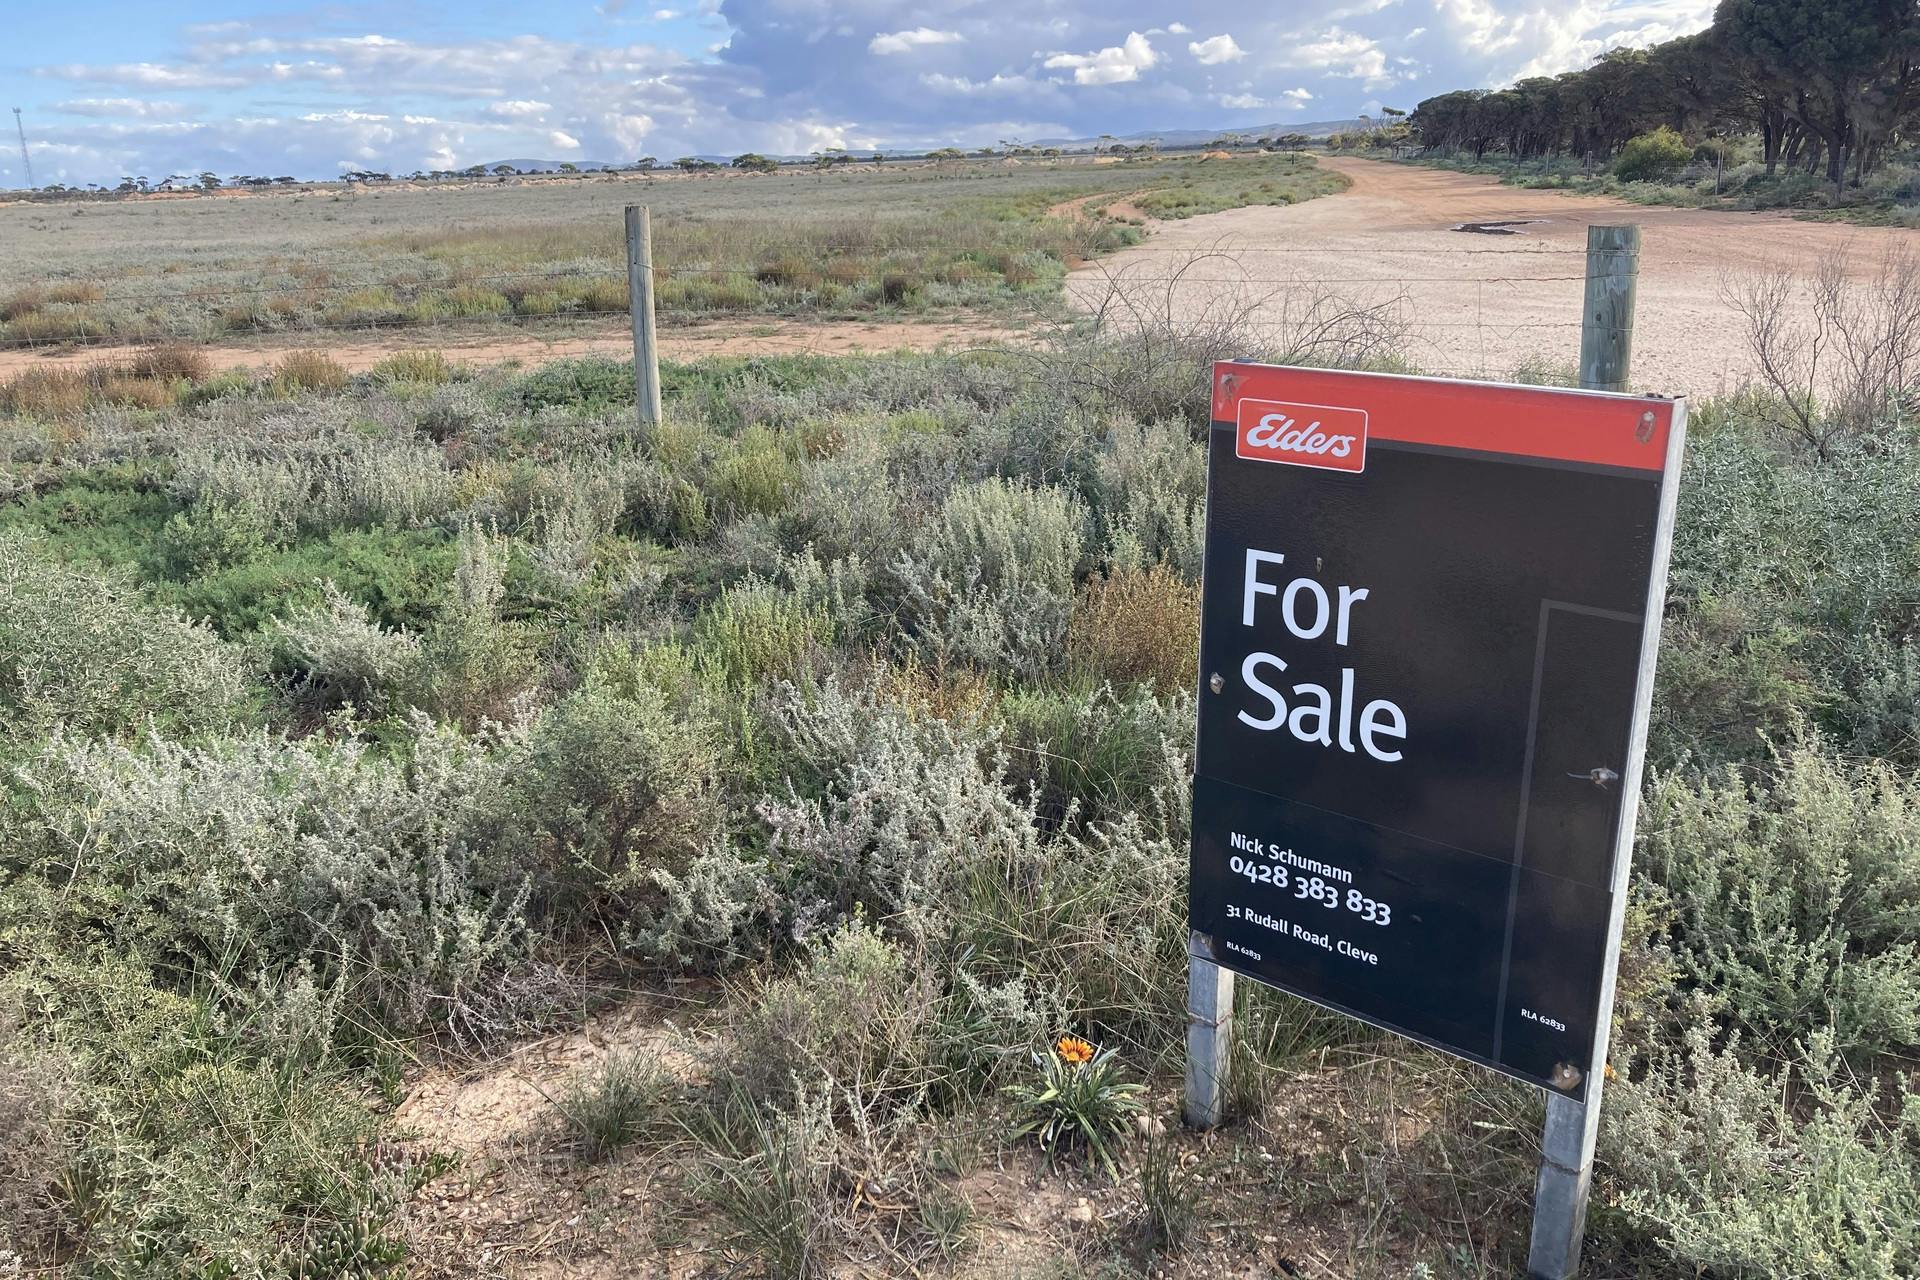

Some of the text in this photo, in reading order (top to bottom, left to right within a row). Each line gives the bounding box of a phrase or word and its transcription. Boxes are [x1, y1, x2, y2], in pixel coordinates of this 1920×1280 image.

[1247, 413, 1356, 457] Elders
[1242, 548, 1369, 646] For
[1237, 652, 1407, 762] Sale
[1230, 831, 1352, 883] Nick Schumann
[1229, 856, 1391, 926] 0428 383 833
[1226, 904, 1378, 965] 31 Rudall Road, Cleve
[1226, 941, 1261, 961] RLA 62833
[1521, 1008, 1566, 1032] RLA 62833
